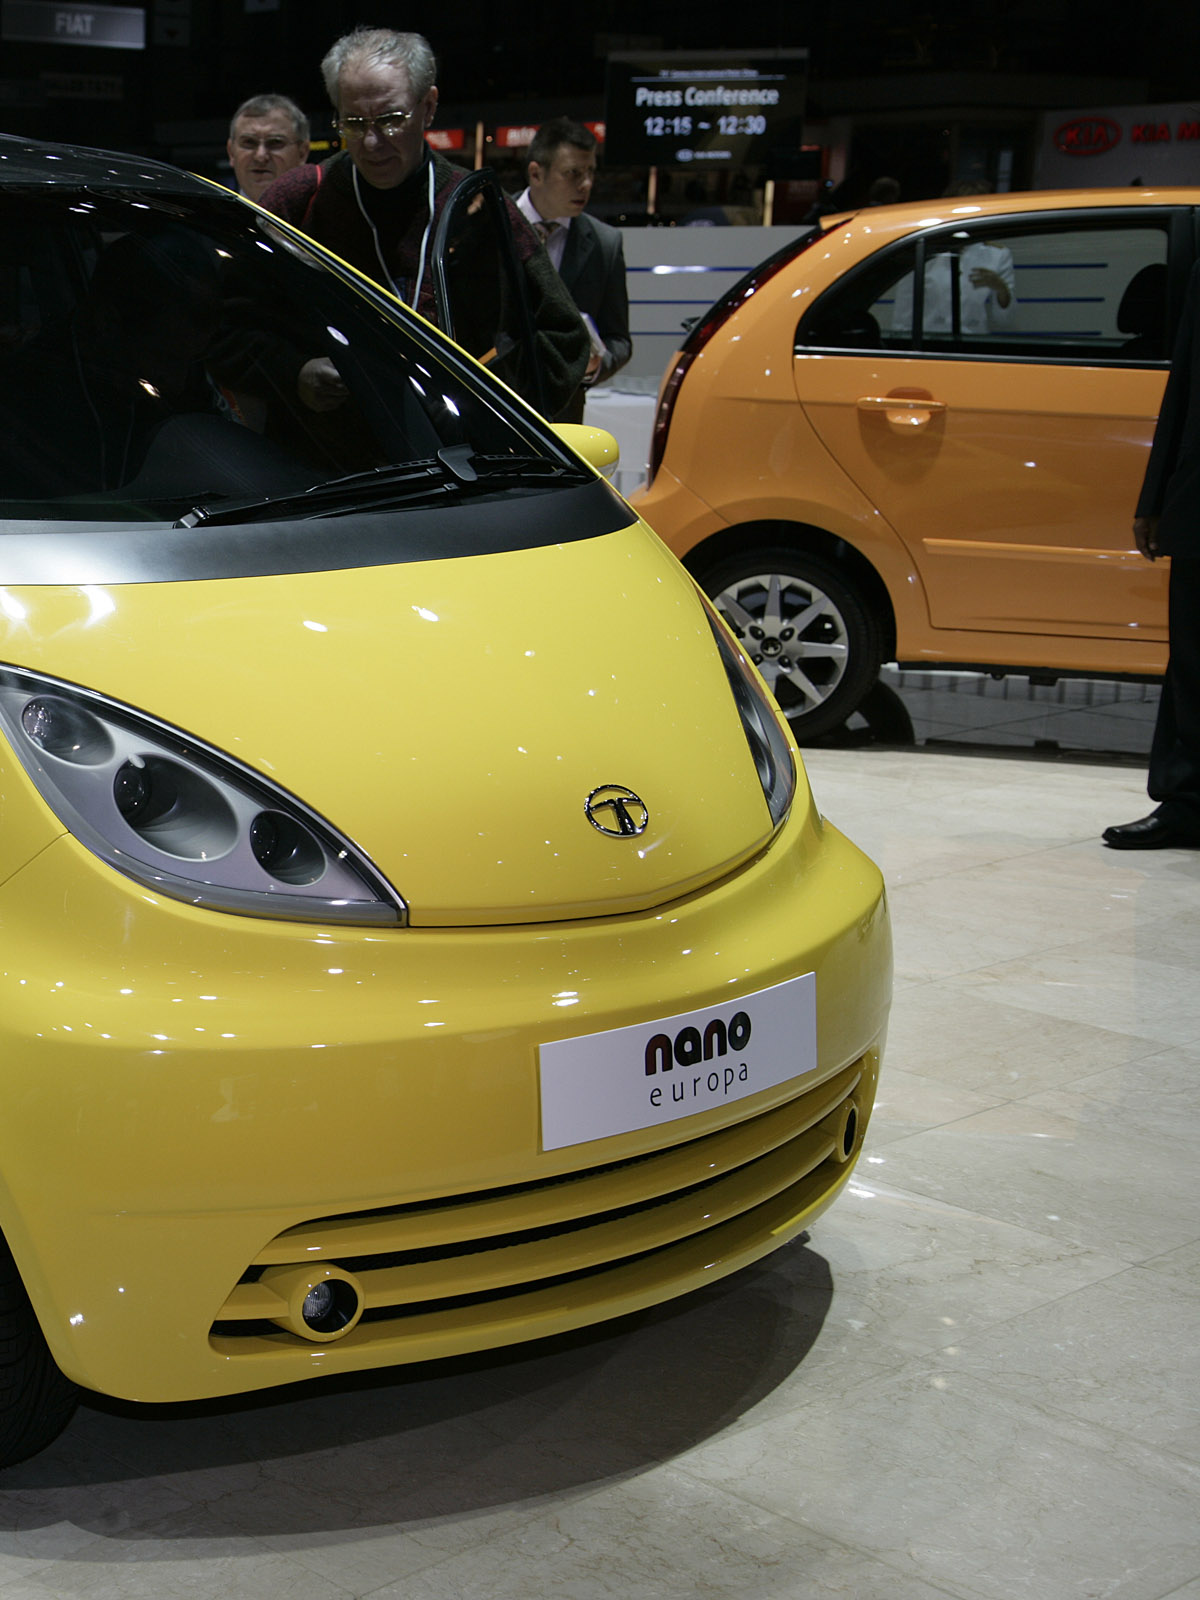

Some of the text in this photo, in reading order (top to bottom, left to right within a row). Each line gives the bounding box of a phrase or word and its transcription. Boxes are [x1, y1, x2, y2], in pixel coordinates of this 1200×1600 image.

[55, 12, 95, 36] FIAT
[636, 86, 780, 107] Press Conference
[644, 115, 692, 136] 12:15
[717, 115, 767, 135] 12:30
[1065, 125, 1109, 145] KIA
[1132, 123, 1171, 143] KIA
[645, 1011, 751, 1075] nano
[649, 1063, 748, 1106] europa
